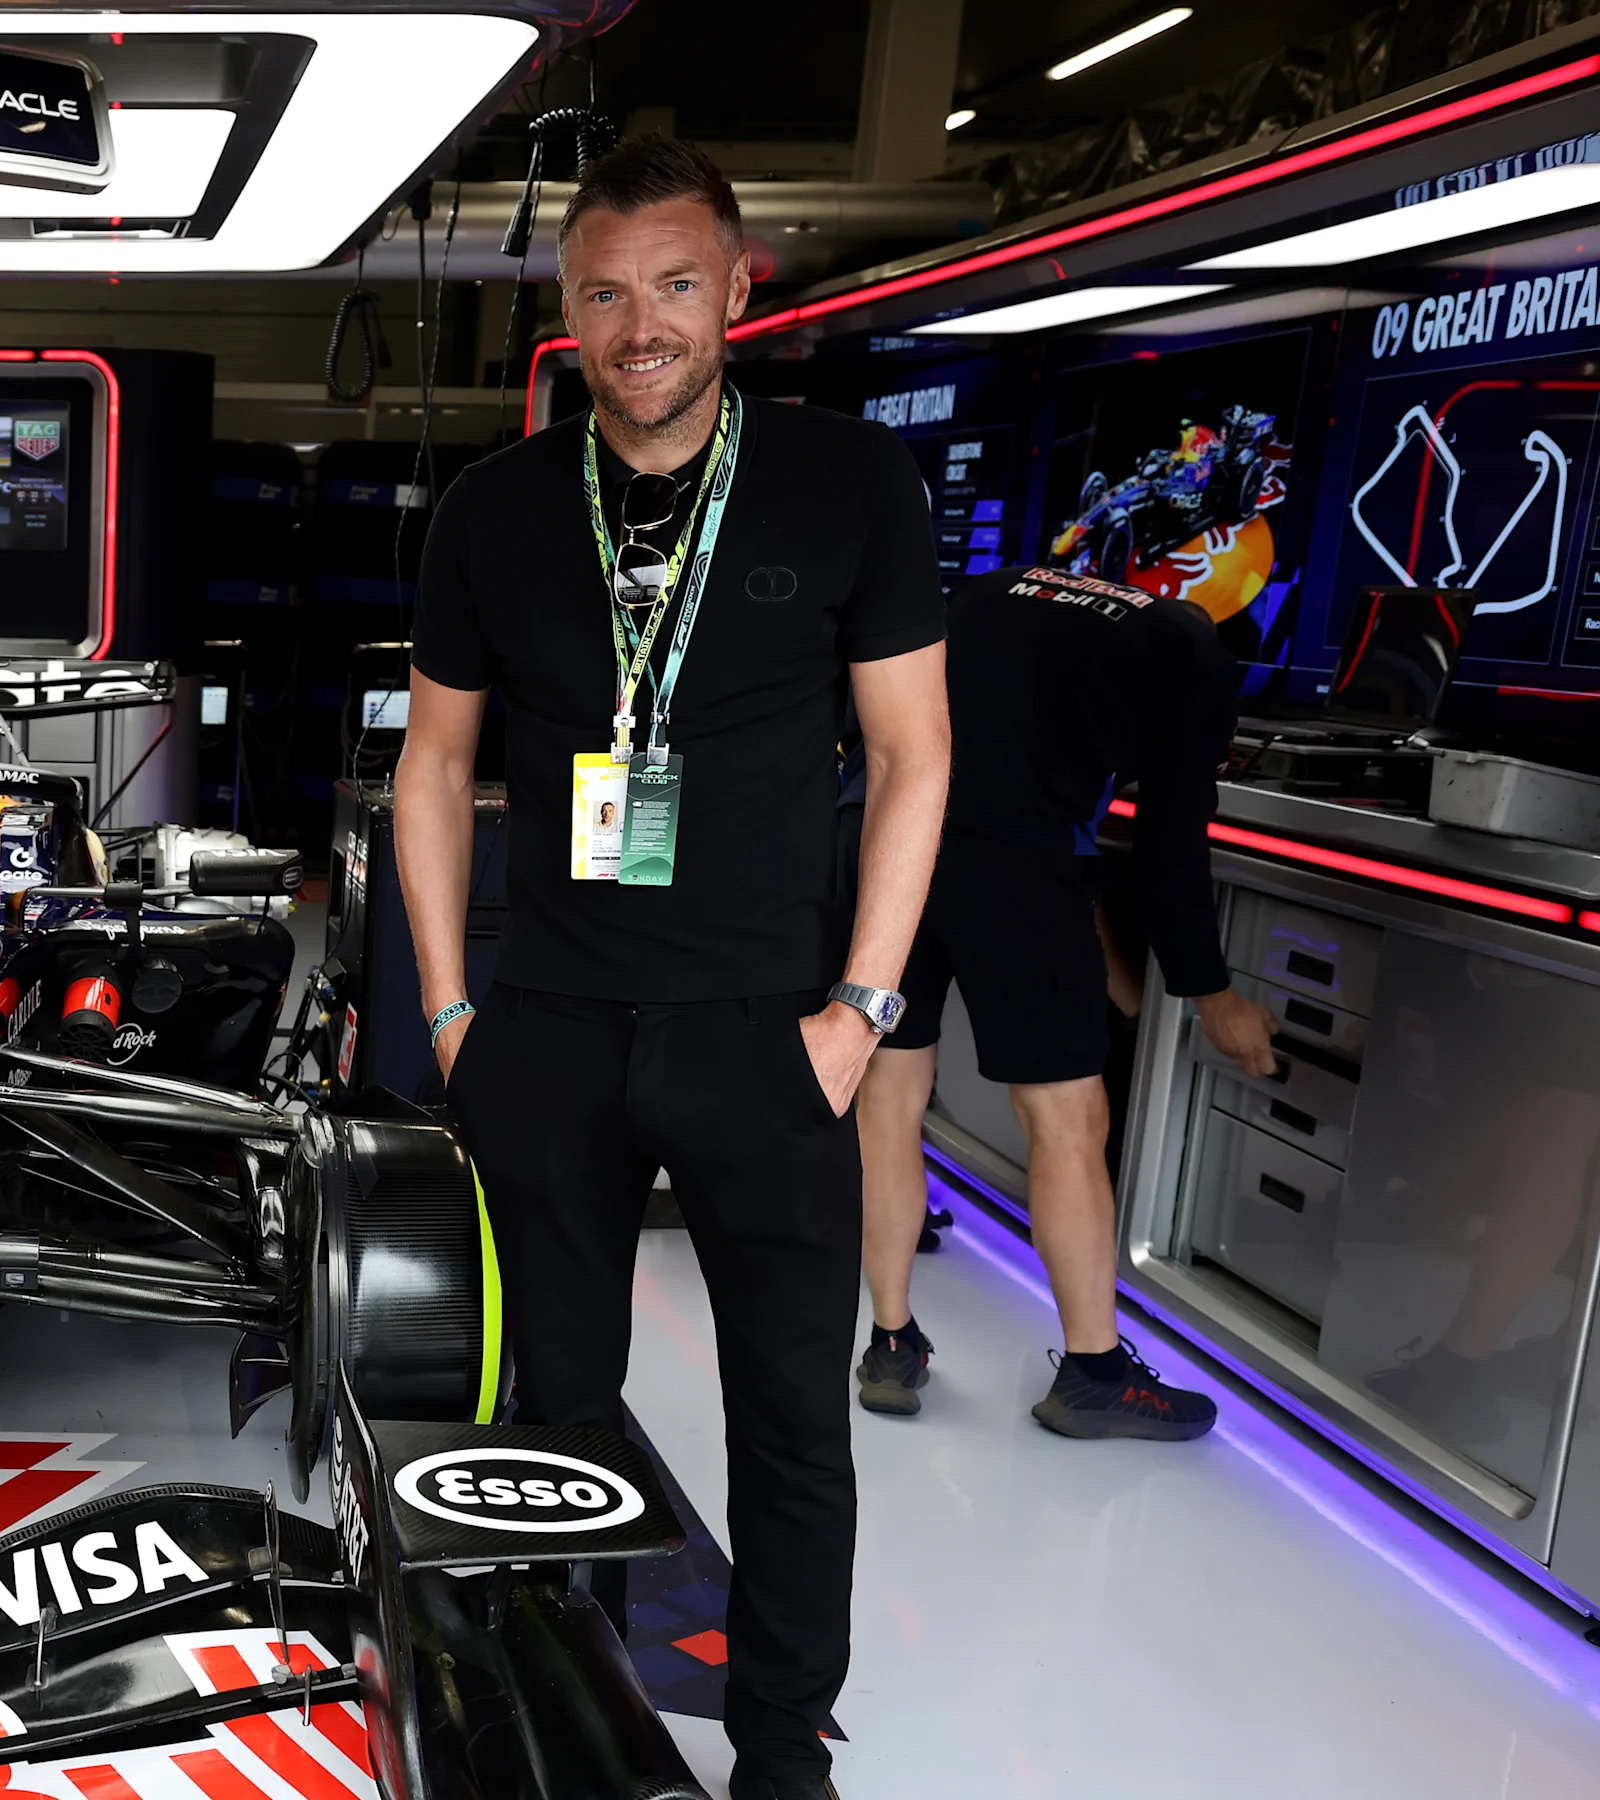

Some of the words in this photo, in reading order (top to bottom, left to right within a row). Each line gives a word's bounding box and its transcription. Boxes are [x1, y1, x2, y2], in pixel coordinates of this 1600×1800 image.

[1371, 302, 1410, 359] 09
[1411, 283, 1507, 353] GREAT
[1504, 266, 1600, 339] BRITA
[19, 423, 57, 437] TAG
[1007, 582, 1096, 608] Mobil
[631, 636, 653, 675] BRITAIN
[630, 772, 679, 781] PADDOCK
[0, 869, 43, 881] Gate
[7, 979, 43, 1045] CARLYLE
[434, 1468, 609, 1509] Esso
[340, 1461, 369, 1588] AT&T
